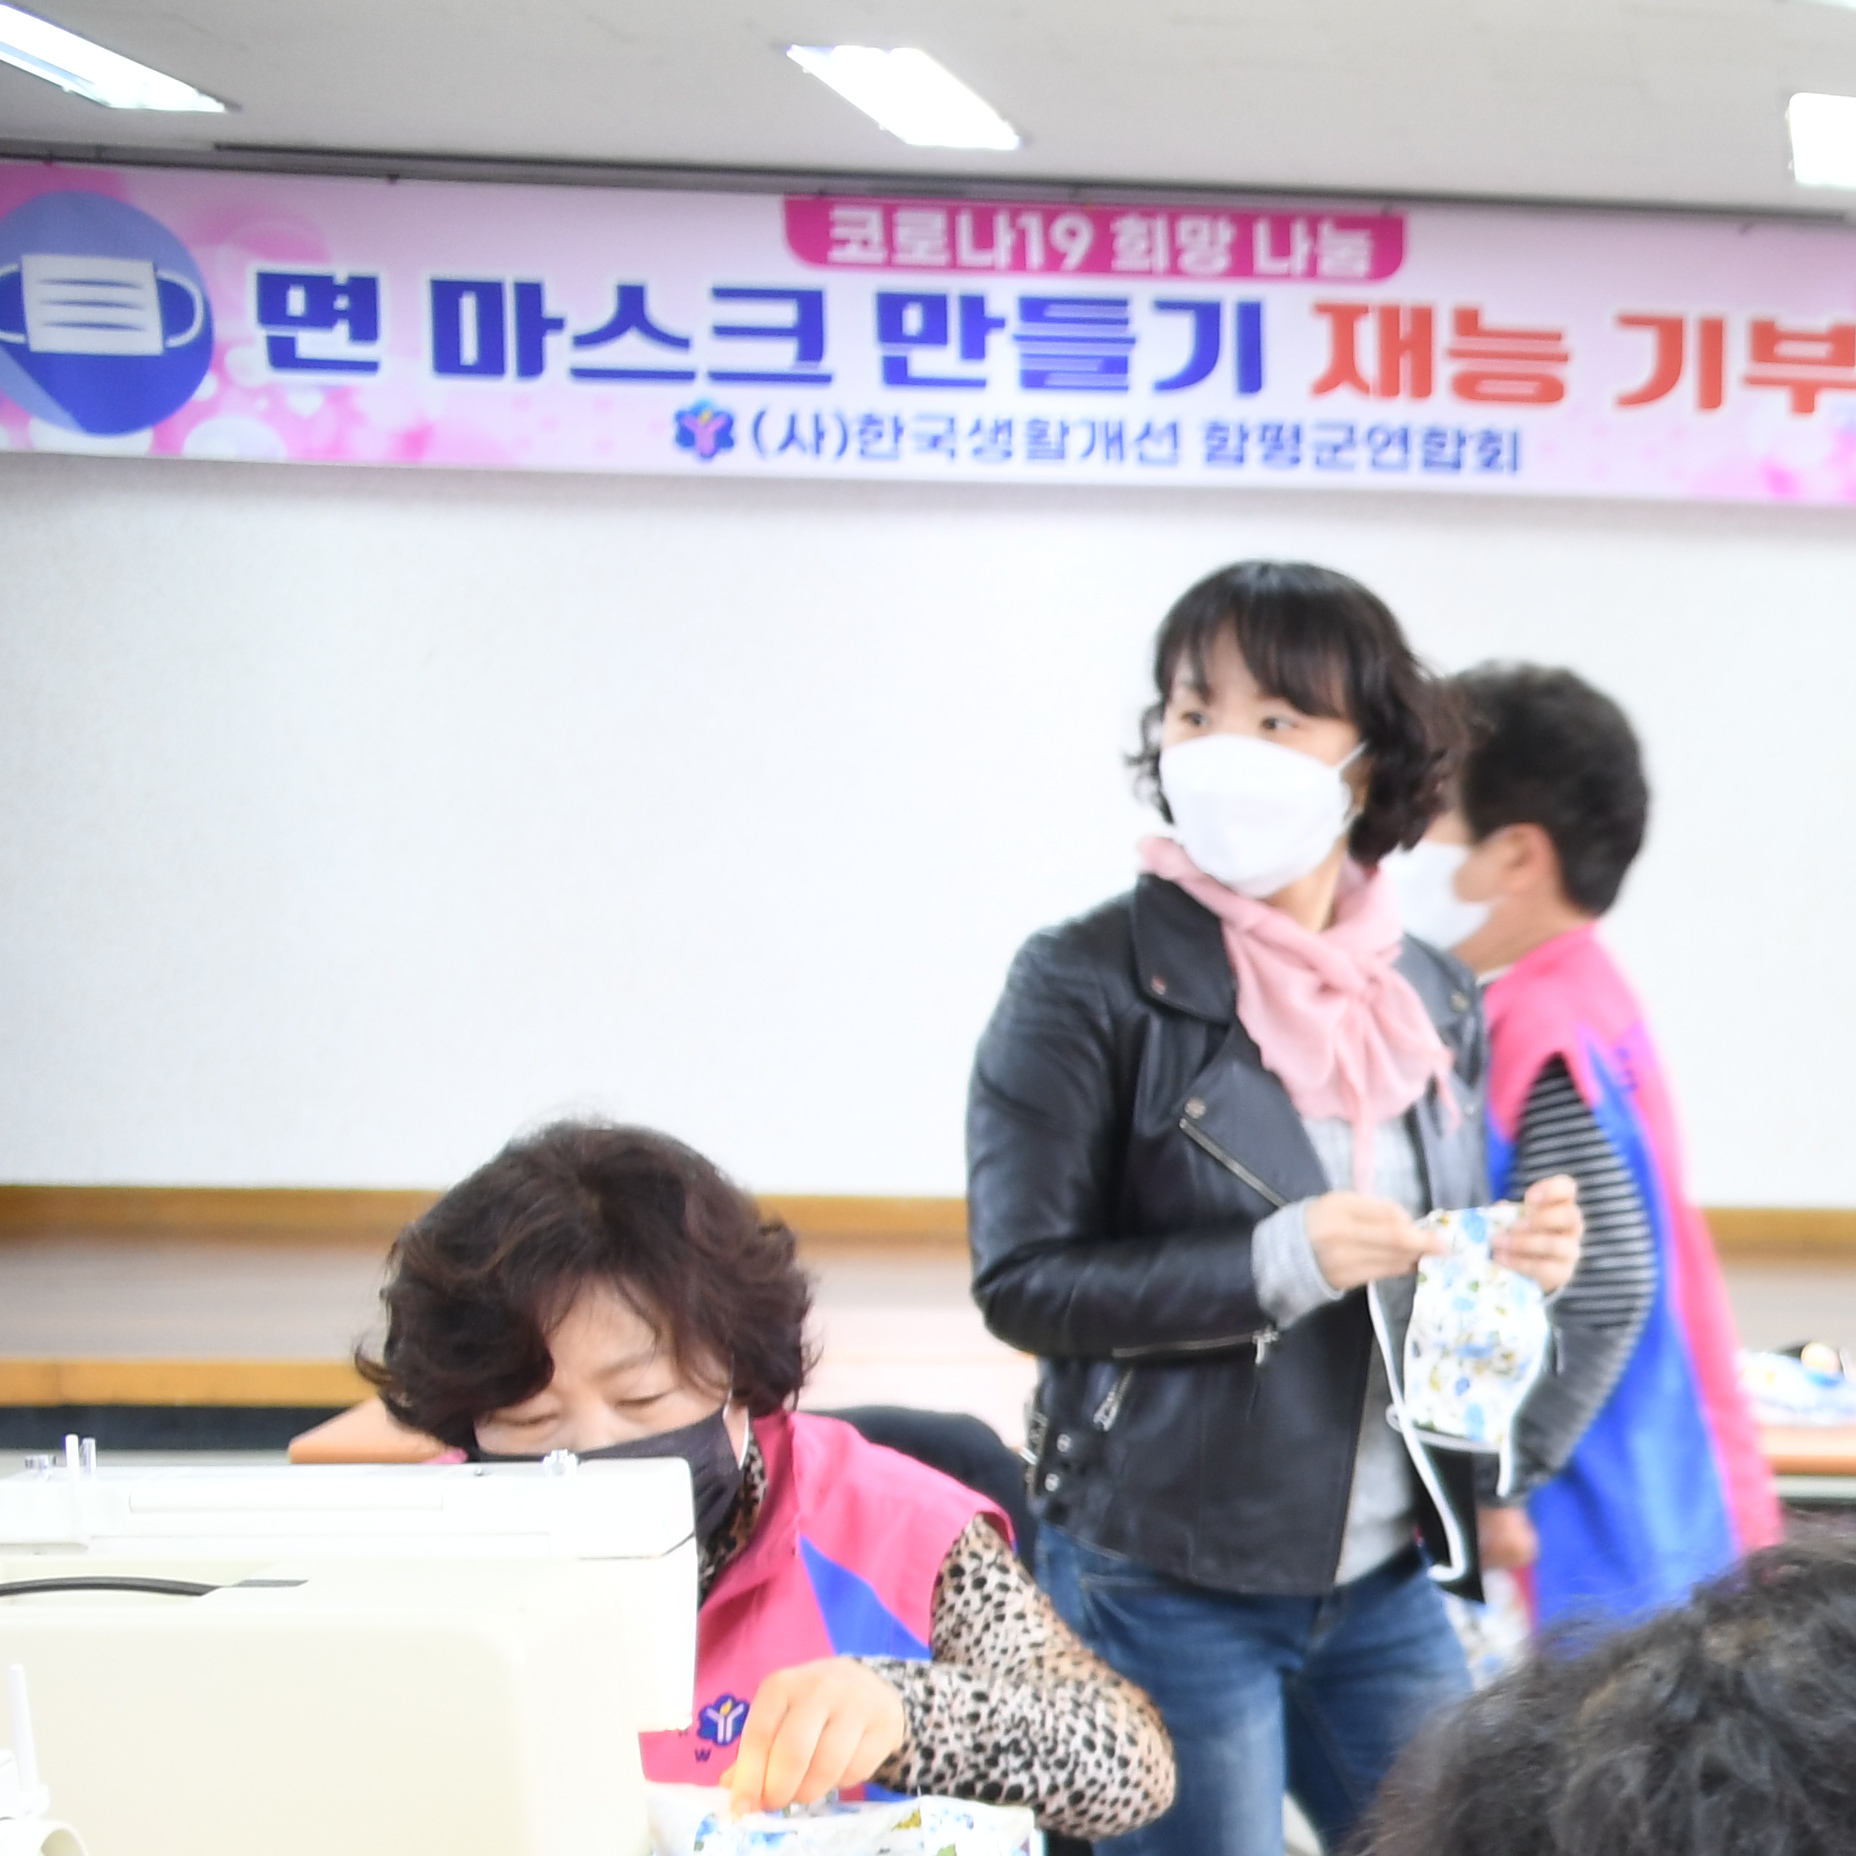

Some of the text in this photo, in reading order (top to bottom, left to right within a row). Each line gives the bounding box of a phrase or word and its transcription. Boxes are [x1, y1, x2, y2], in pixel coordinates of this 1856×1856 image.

[827, 204, 1374, 280] 코로나19 희망 나눔
[256, 271, 379, 373] 면
[430, 278, 832, 383] 마스크
[876, 292, 1262, 395] 만들기
[1311, 302, 1569, 403] 재능
[752, 408, 1180, 465] (사)한국생활개선
